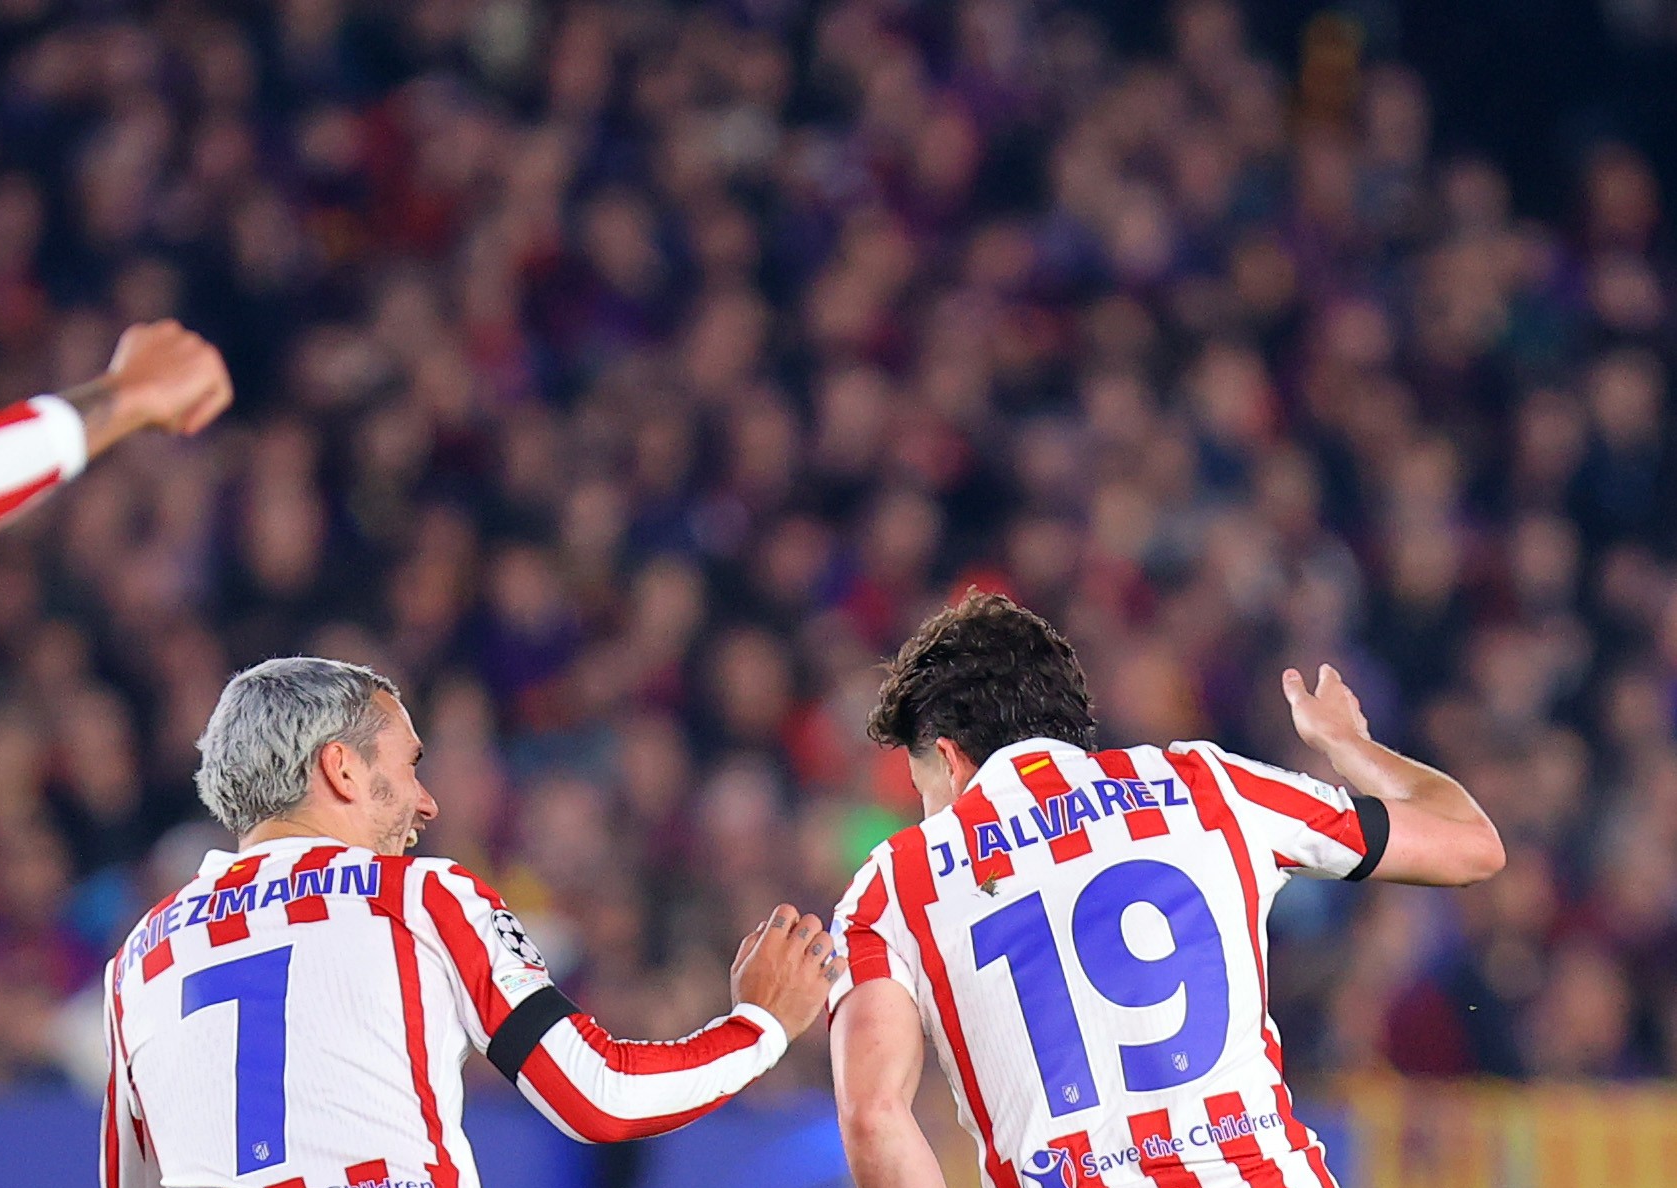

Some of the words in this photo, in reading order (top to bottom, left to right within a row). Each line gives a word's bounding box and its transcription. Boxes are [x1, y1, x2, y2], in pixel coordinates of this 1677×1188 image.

[931, 841, 970, 877] J.
[974, 778, 1189, 861] ALVAREZ
[181, 943, 294, 1176] 7
[970, 859, 1230, 1118] 19
[1081, 1146, 1140, 1177] Save
[1143, 1135, 1185, 1158] the
[1189, 1112, 1283, 1146] Children
